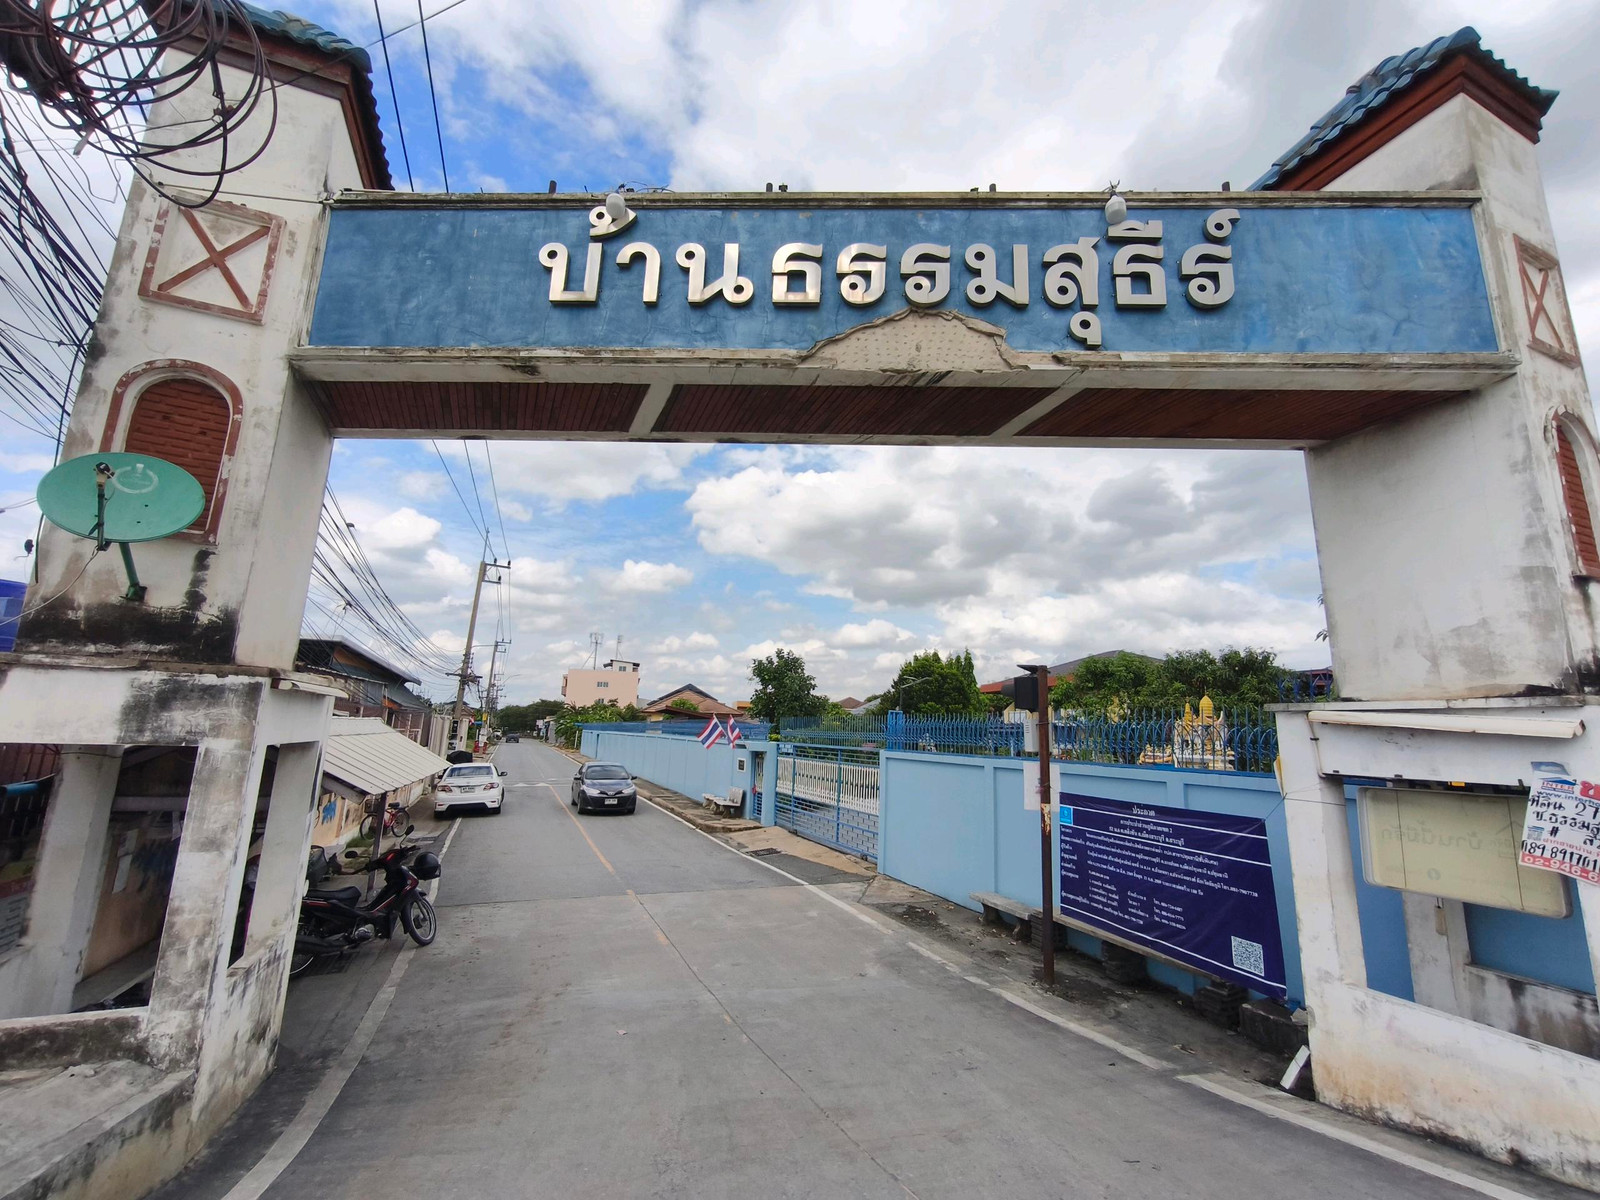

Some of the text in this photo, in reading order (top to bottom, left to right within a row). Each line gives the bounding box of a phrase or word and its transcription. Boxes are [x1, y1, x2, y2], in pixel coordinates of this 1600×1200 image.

[538, 206, 1241, 346] บ้านธรรมสุธีร์
